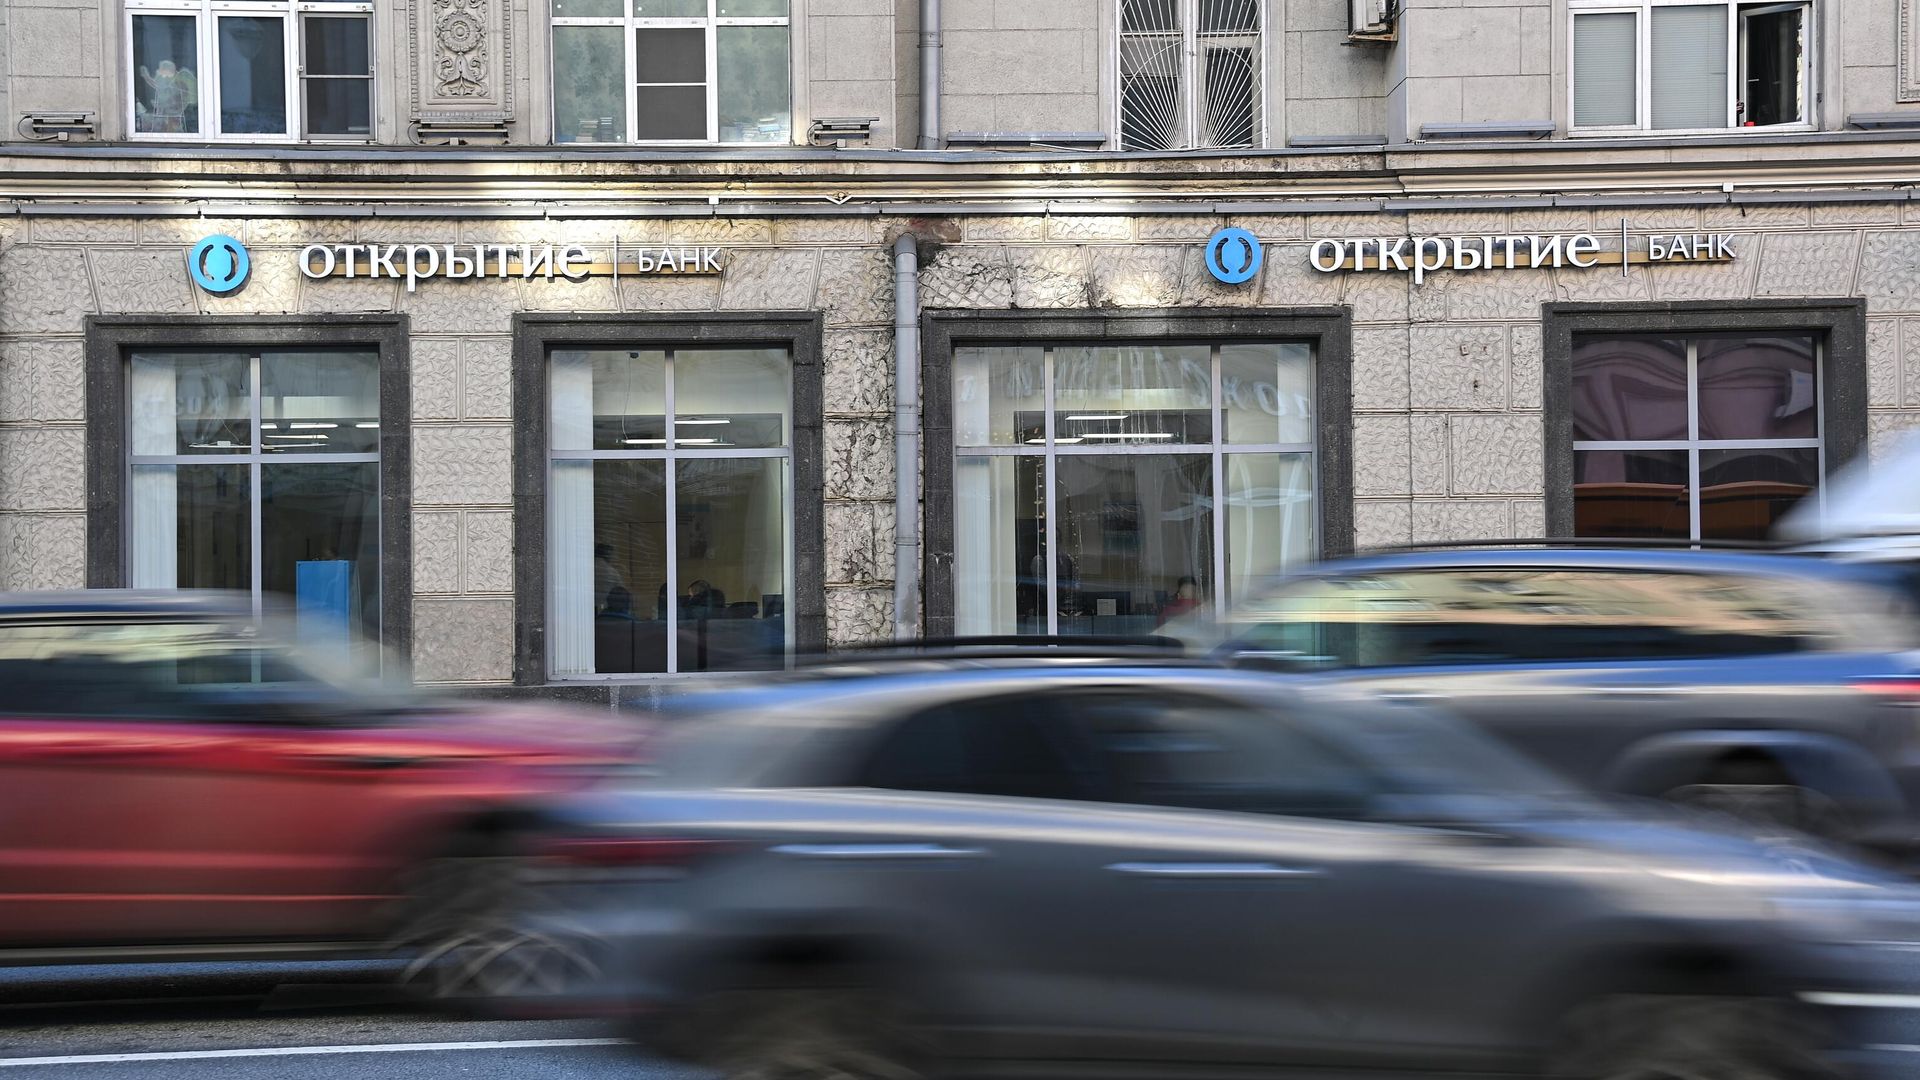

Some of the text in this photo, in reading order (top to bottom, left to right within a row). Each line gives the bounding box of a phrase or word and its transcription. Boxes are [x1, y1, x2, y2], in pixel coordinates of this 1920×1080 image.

[299, 244, 722, 292] открытие БАНК
[1309, 233, 1736, 285] открытие БАНК
